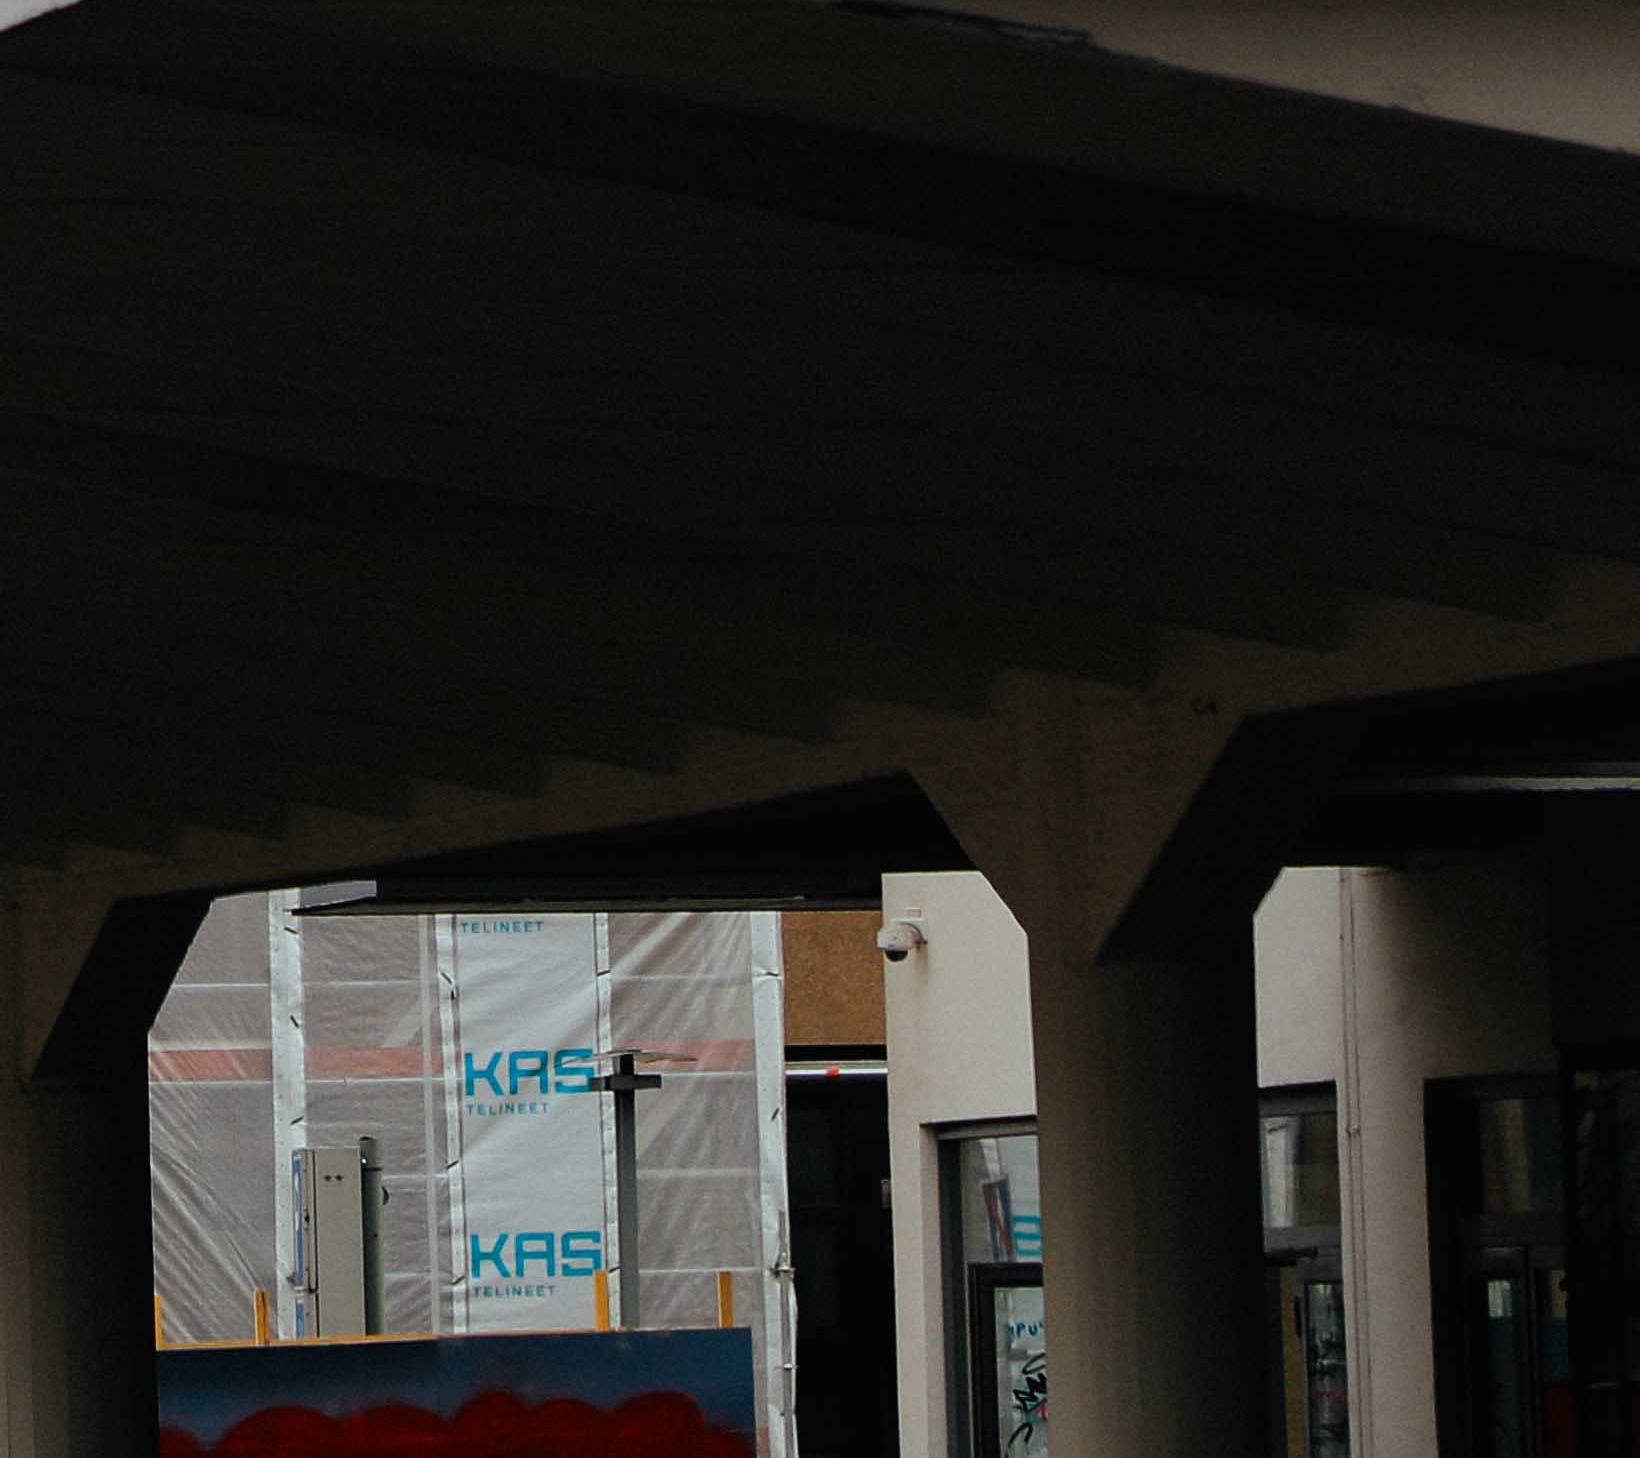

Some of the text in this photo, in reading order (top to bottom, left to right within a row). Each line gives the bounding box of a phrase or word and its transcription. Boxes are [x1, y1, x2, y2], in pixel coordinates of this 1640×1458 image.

[460, 921, 544, 934] TELINEET
[465, 1049, 595, 1096] KAS
[467, 1101, 552, 1117] TELINEET
[471, 1231, 602, 1277] KAS
[474, 1284, 557, 1298] TELINEET
